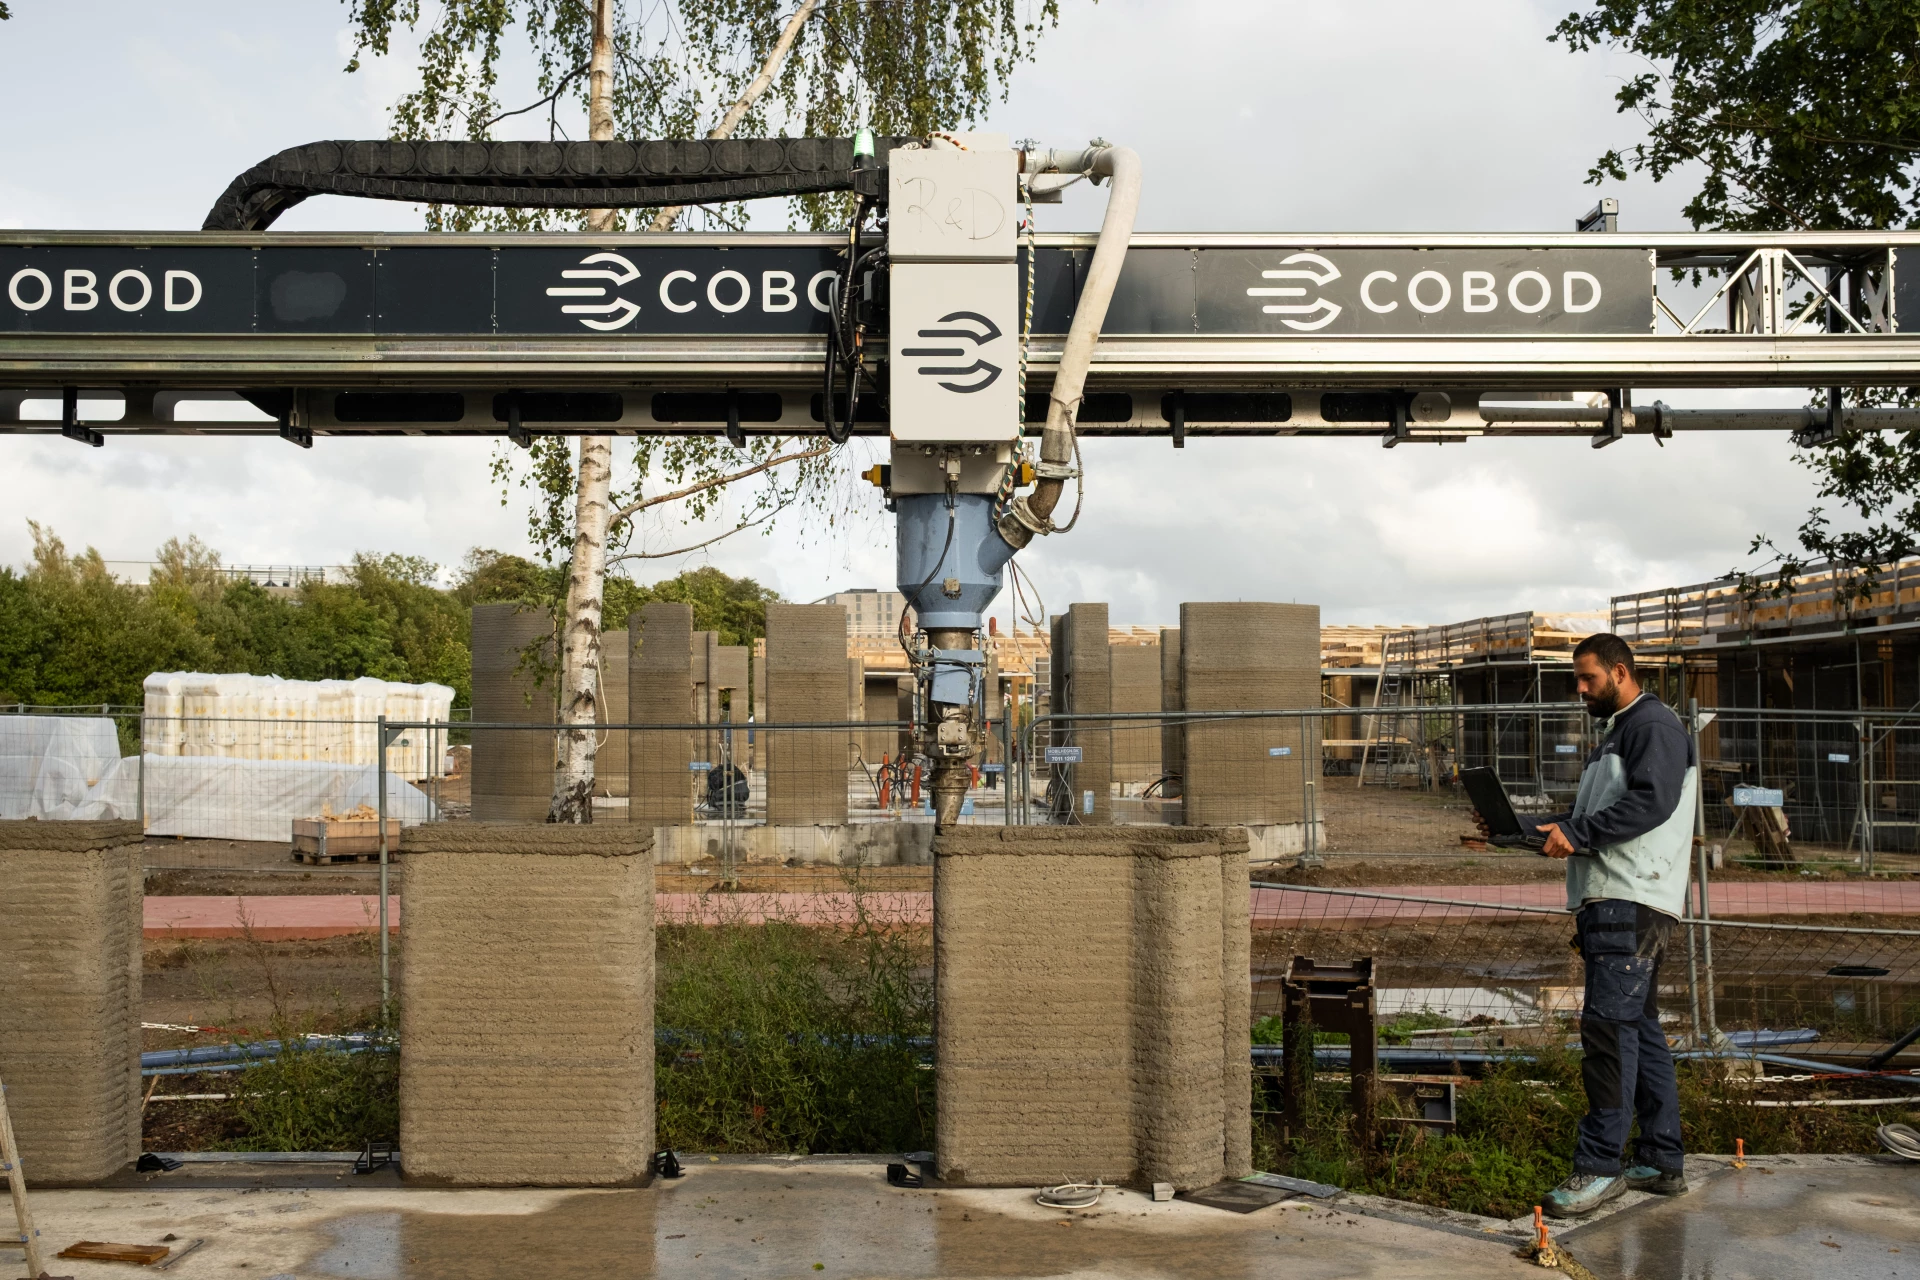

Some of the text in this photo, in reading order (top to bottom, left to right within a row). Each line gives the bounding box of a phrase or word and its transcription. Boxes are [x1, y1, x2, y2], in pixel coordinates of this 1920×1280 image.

[904, 177, 1006, 241] R&D
[8, 268, 203, 312] OBOD
[659, 270, 874, 313] COBO
[1359, 270, 1602, 314] COBOD
